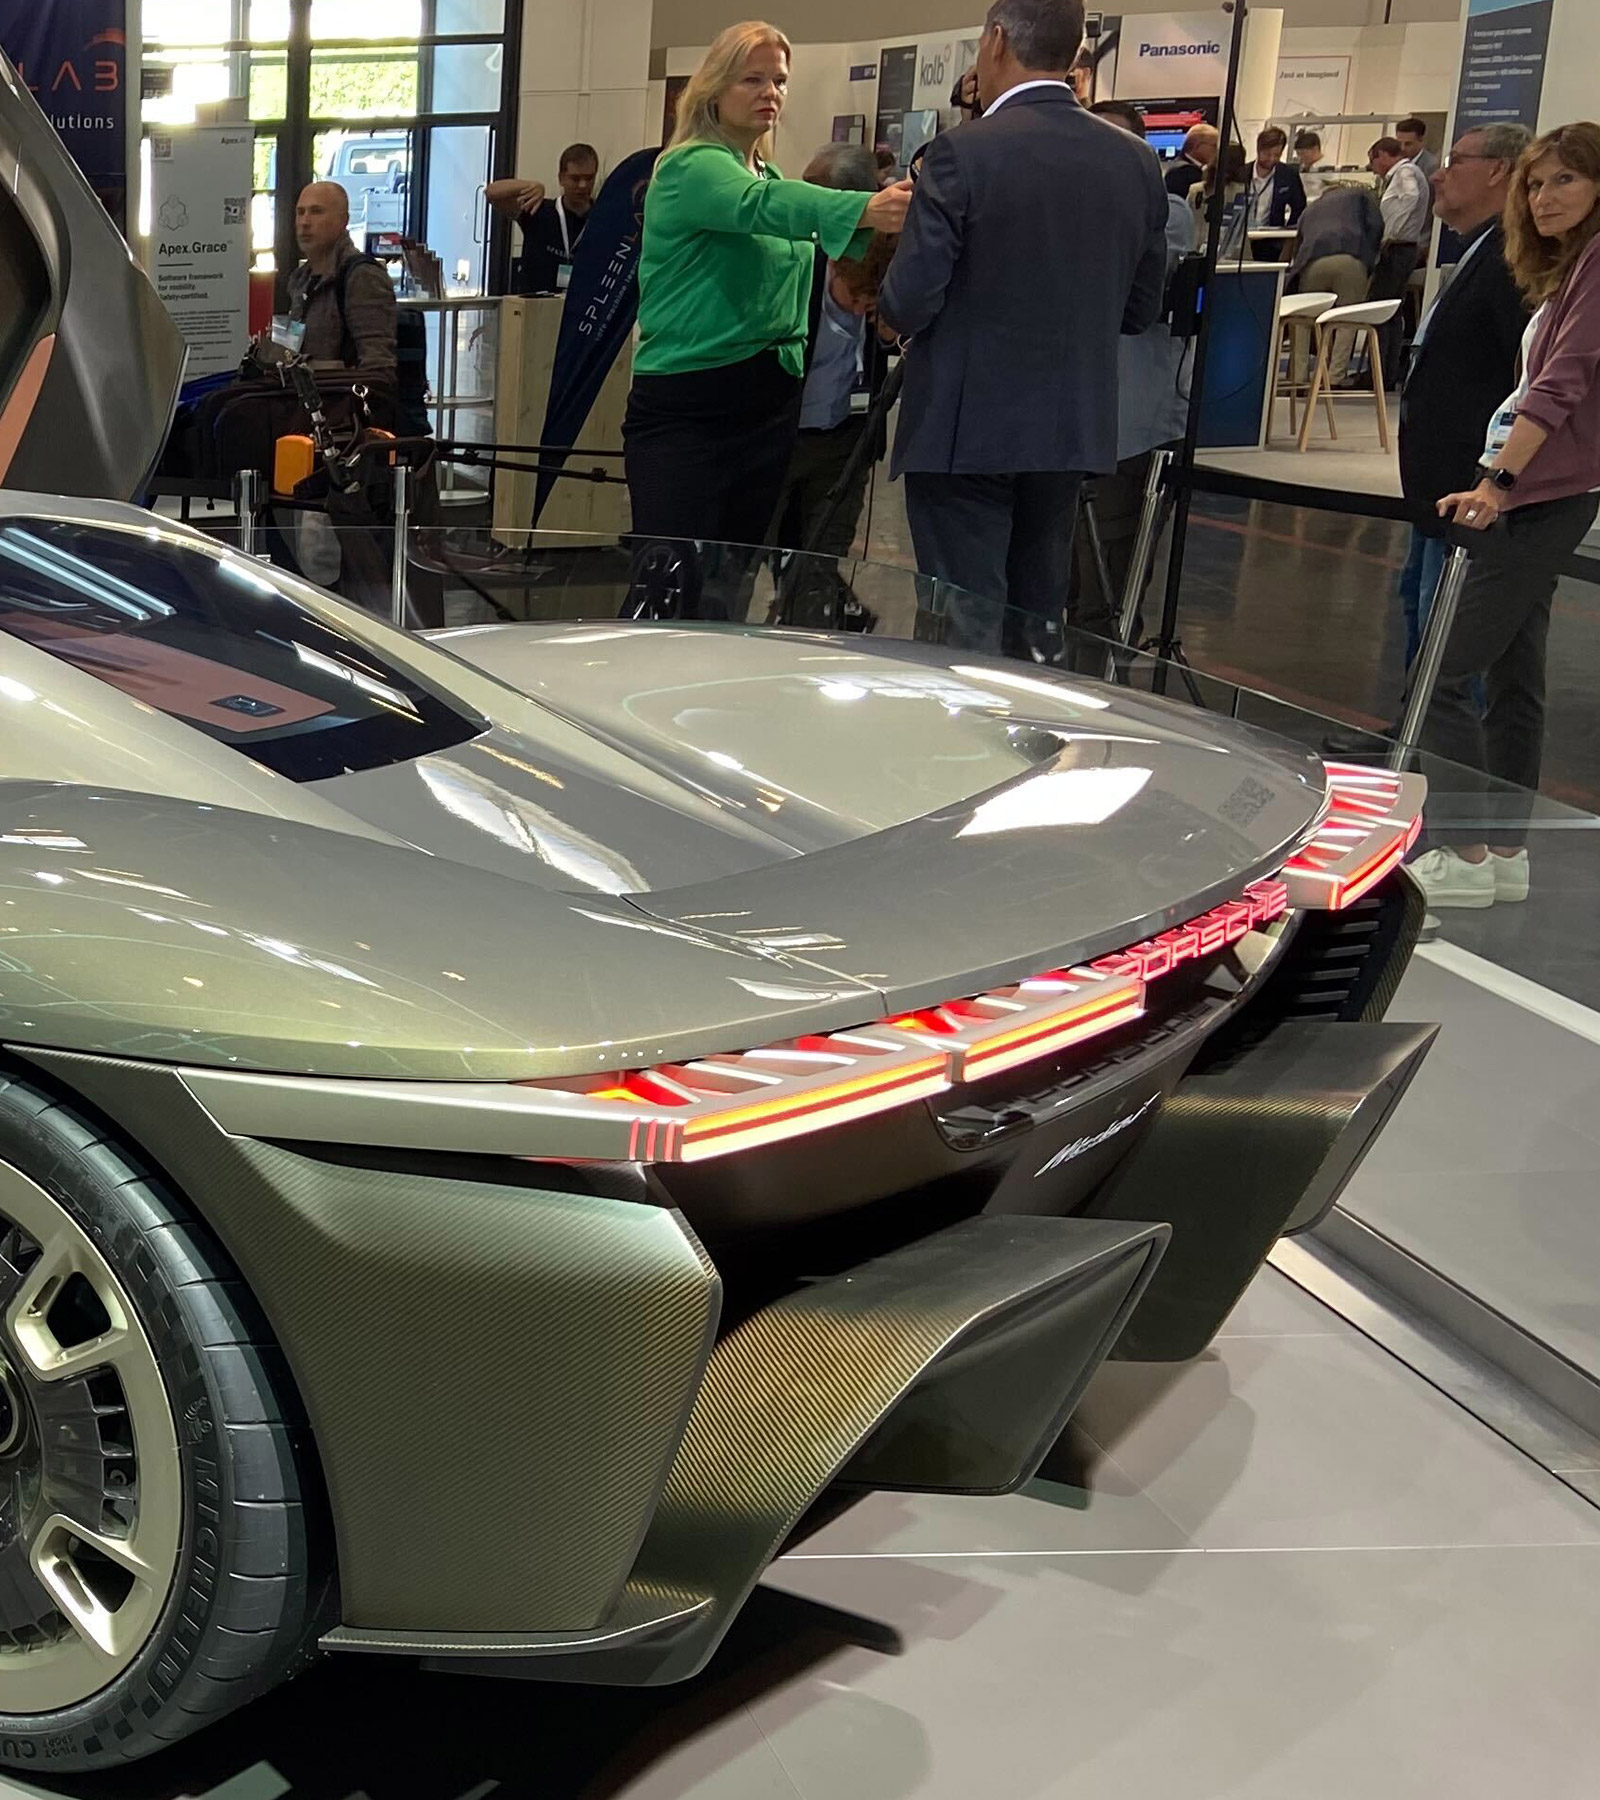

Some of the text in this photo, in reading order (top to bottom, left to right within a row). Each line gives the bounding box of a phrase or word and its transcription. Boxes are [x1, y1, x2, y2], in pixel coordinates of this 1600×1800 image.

[1139, 40, 1221, 57] Panasonic
[920, 54, 945, 86] kolb
[158, 241, 228, 257] Apex.Grace
[154, 1455, 220, 1689] MICHELIN
